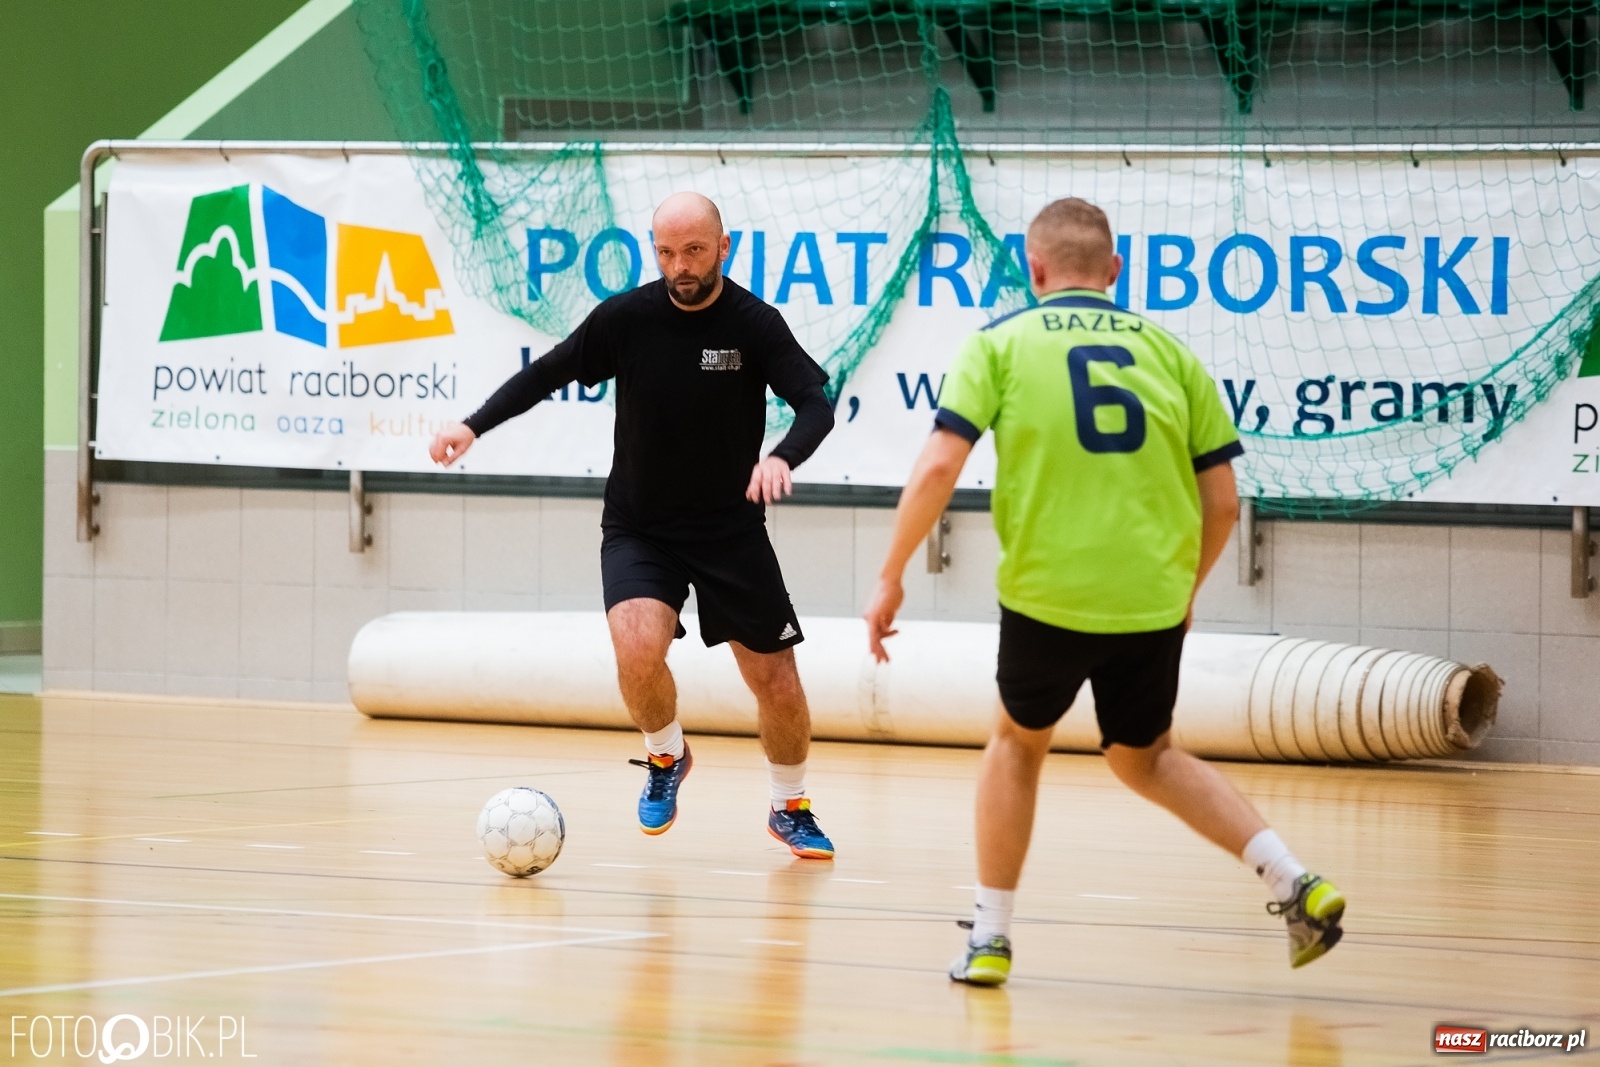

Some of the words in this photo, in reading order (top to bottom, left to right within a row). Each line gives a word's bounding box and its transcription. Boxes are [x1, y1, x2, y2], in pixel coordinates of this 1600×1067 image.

[918, 232, 1510, 316] RAIBORSKI
[153, 357, 267, 401] powiat
[289, 361, 457, 400] raciborski
[1067, 345, 1147, 454] 6
[1292, 378, 1518, 442] gramy
[151, 405, 256, 431] zielona
[277, 414, 345, 436] oaza
